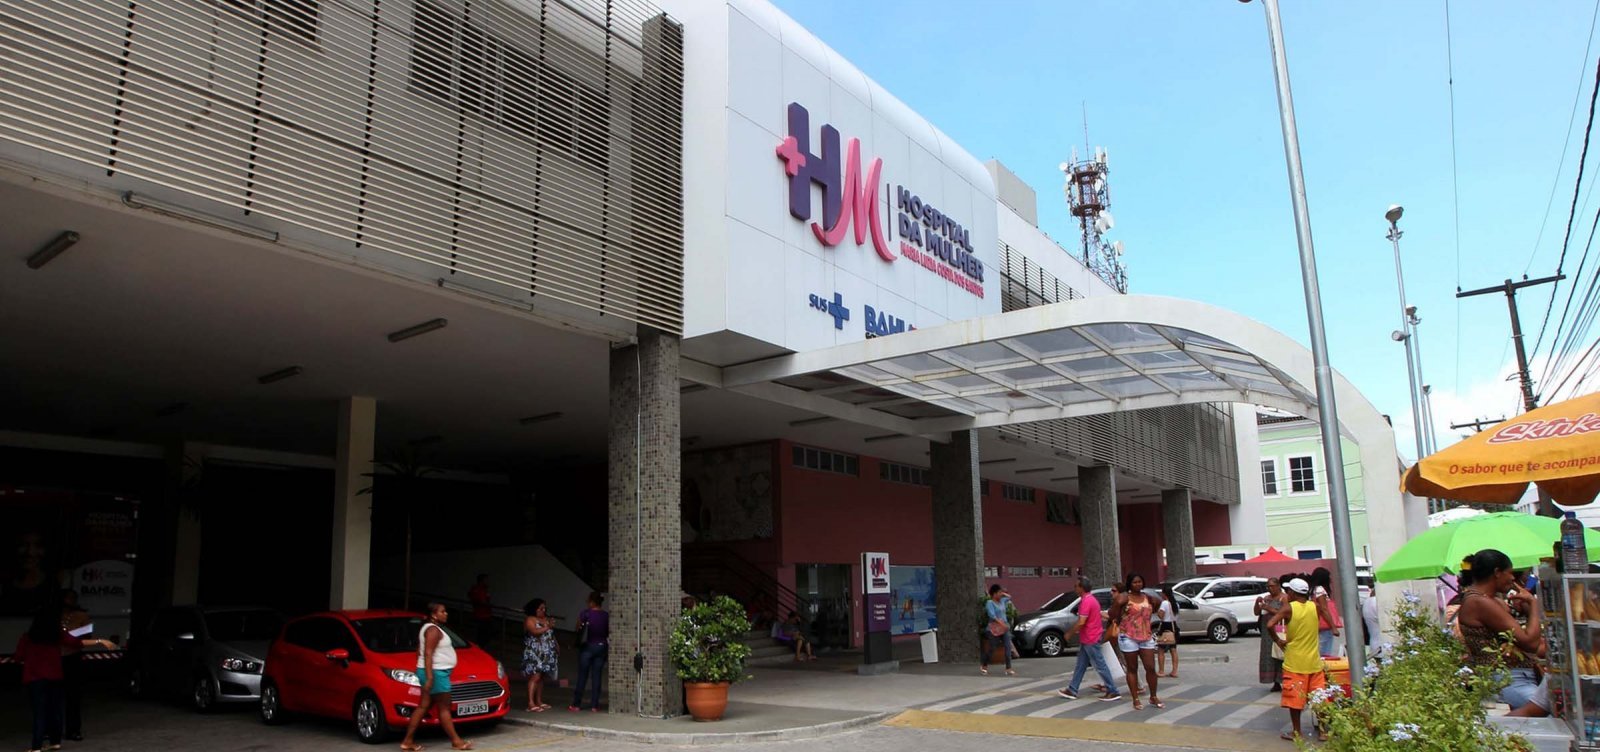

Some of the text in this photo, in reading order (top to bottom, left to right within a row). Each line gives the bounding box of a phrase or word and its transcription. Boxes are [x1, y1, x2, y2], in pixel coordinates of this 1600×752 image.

[897, 185, 974, 253] HOSPITAL
[898, 212, 985, 283] DA MULHER
[809, 293, 828, 312] SUS
[1449, 464, 1459, 475] O
[1461, 464, 1497, 475] sabor
[1499, 462, 1524, 475] que
[1527, 461, 1540, 471] te
